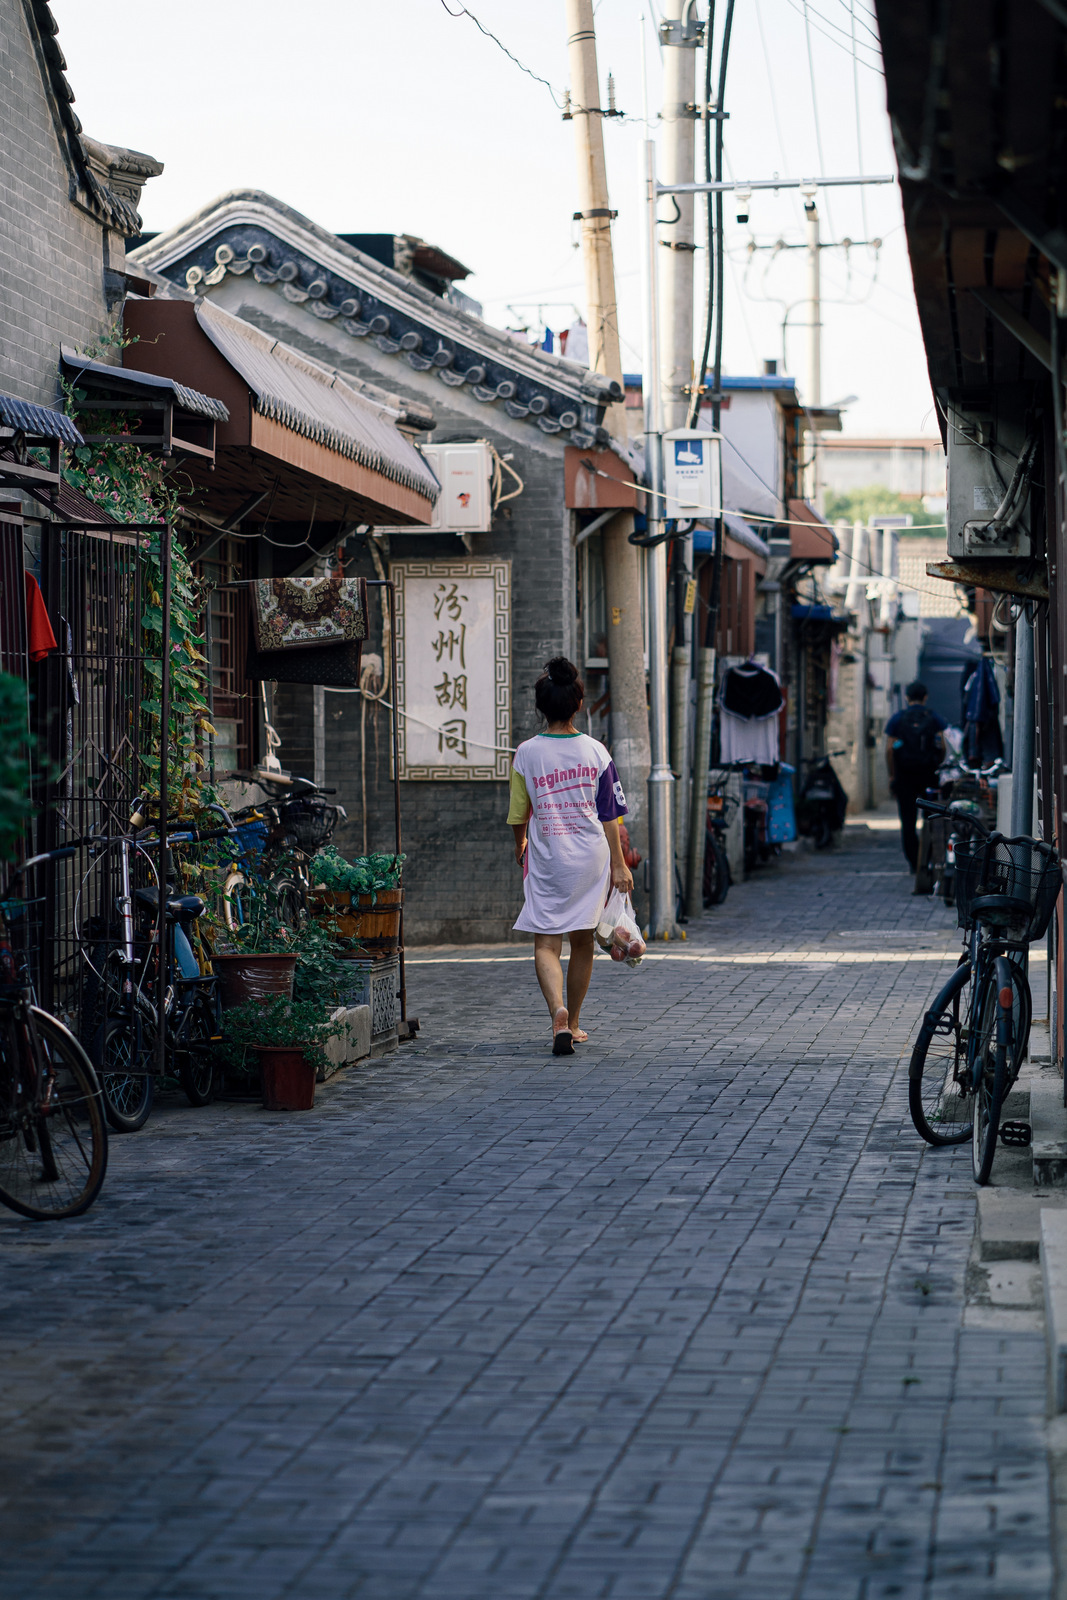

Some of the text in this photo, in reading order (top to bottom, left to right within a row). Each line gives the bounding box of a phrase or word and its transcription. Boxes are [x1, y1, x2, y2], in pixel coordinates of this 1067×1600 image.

[431, 583, 469, 760] 汾州胡同
[532, 763, 598, 789] Beginning
[544, 801, 562, 811] Spring
